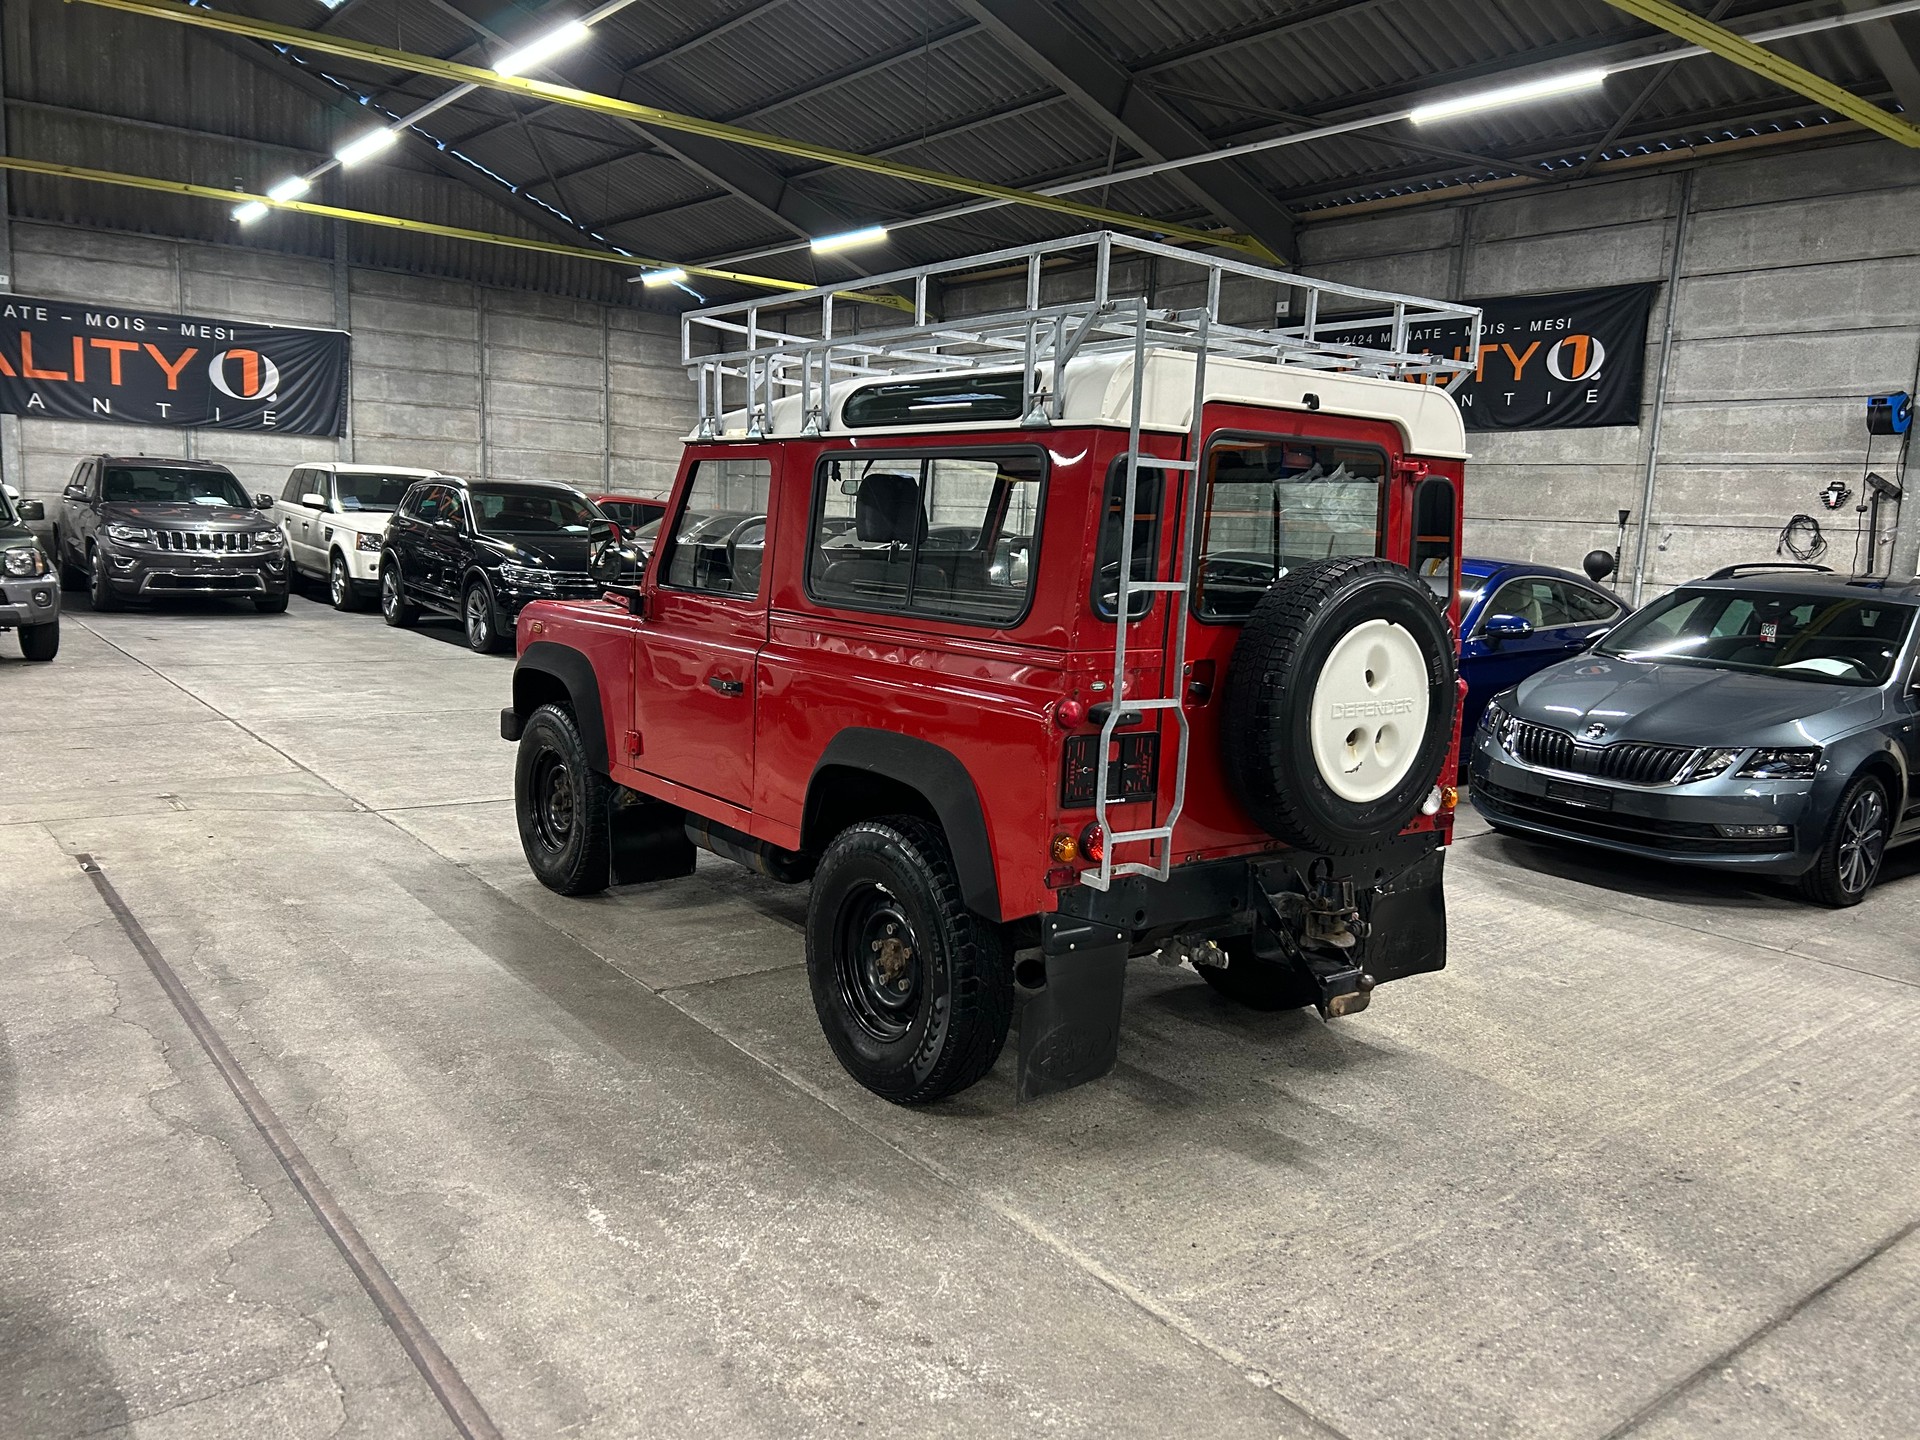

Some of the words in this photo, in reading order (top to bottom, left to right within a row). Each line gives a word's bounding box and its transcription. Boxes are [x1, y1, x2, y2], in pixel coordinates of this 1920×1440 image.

[85, 312, 146, 332] MOIS
[181, 324, 235, 341] MESI
[1380, 328, 1442, 343] MNATE
[1530, 318, 1572, 332] MESI
[1330, 696, 1415, 720] DEFENDER
